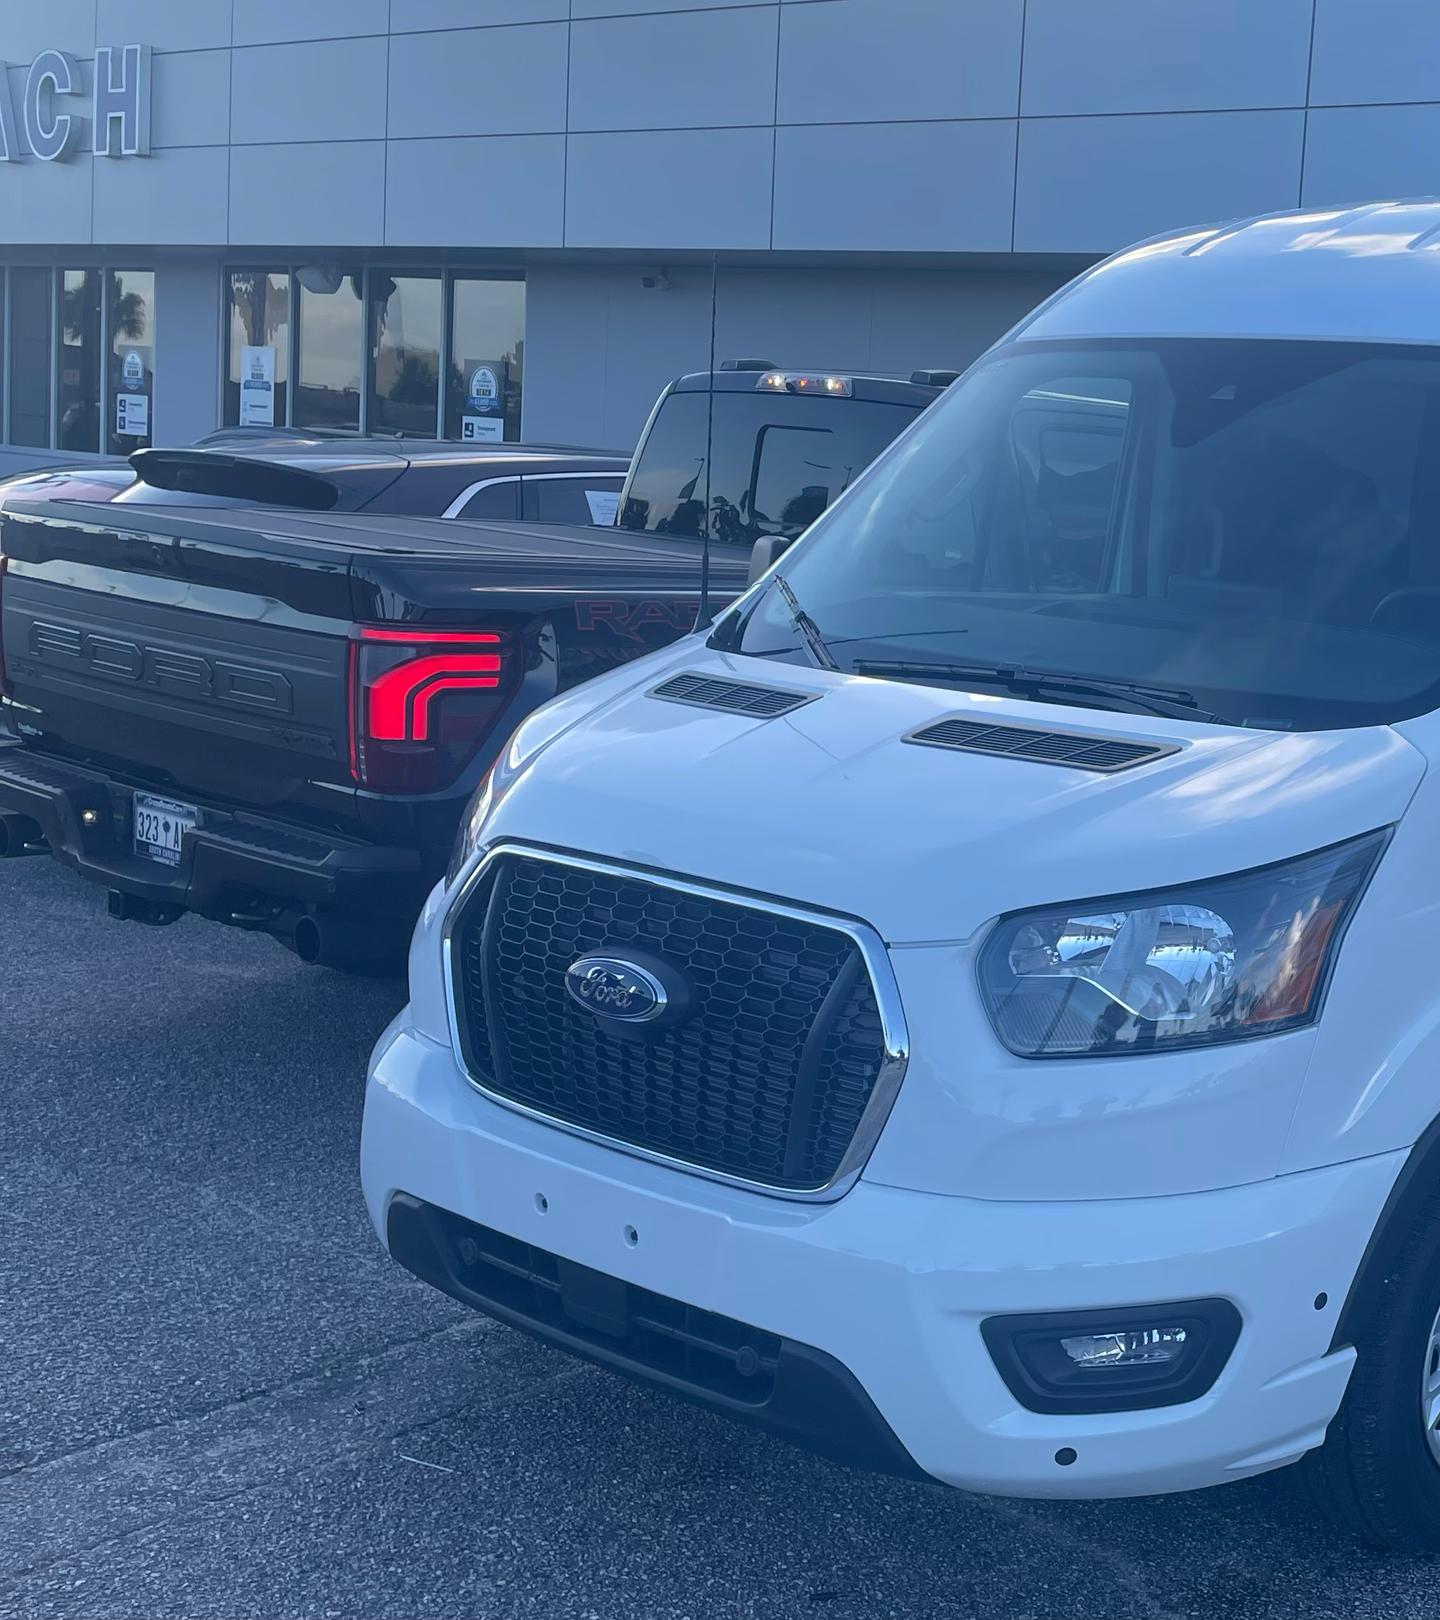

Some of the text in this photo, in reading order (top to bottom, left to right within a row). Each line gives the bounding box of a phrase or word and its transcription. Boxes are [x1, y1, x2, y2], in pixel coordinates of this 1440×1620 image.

[0, 44, 151, 162] CH
[29, 621, 294, 714] FORD
[138, 811, 159, 842] 323
[580, 966, 637, 1008] Ford
